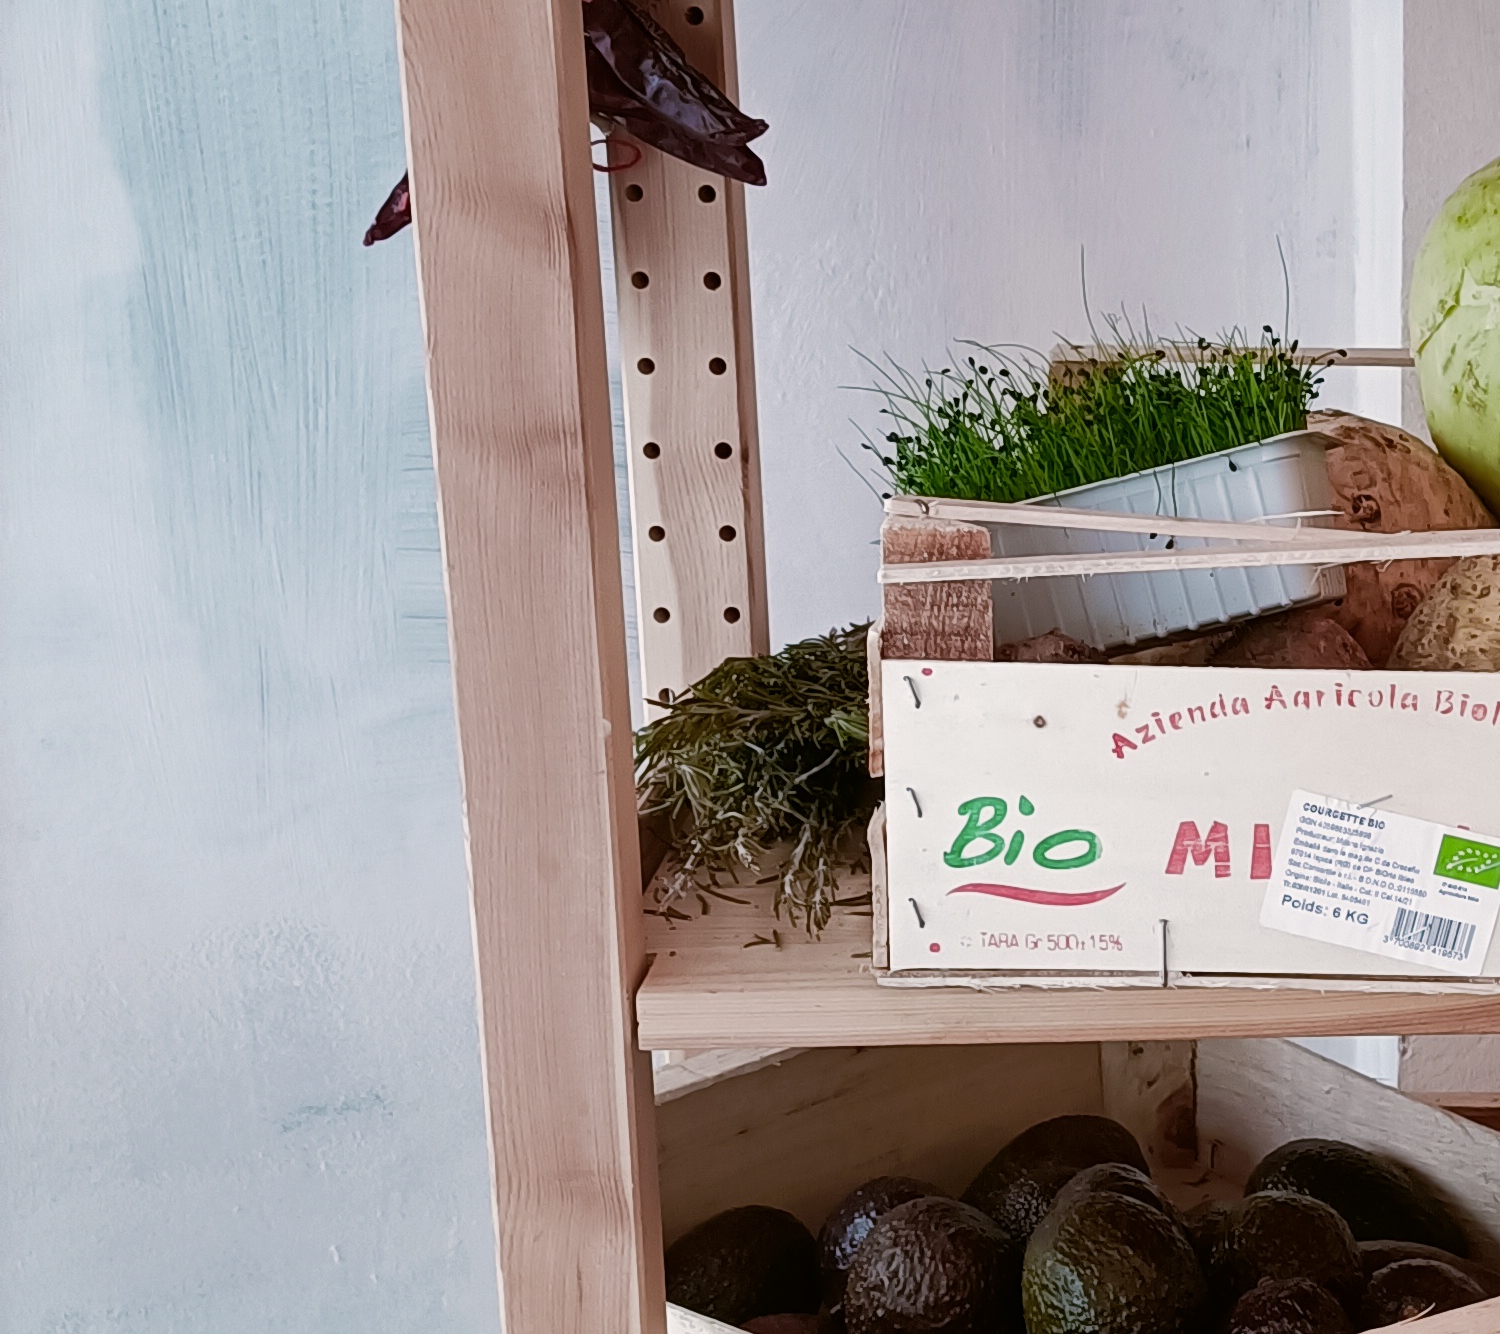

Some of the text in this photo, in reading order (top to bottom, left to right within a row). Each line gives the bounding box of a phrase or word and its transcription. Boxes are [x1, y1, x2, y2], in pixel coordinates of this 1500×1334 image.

[1112, 692, 1250, 759] Azienda
[1302, 802, 1385, 830] COURGETTE BIO
[943, 795, 1102, 870] Bio
[1281, 894, 1369, 924] Poids: 6 KG
[980, 932, 1019, 948] TARA
